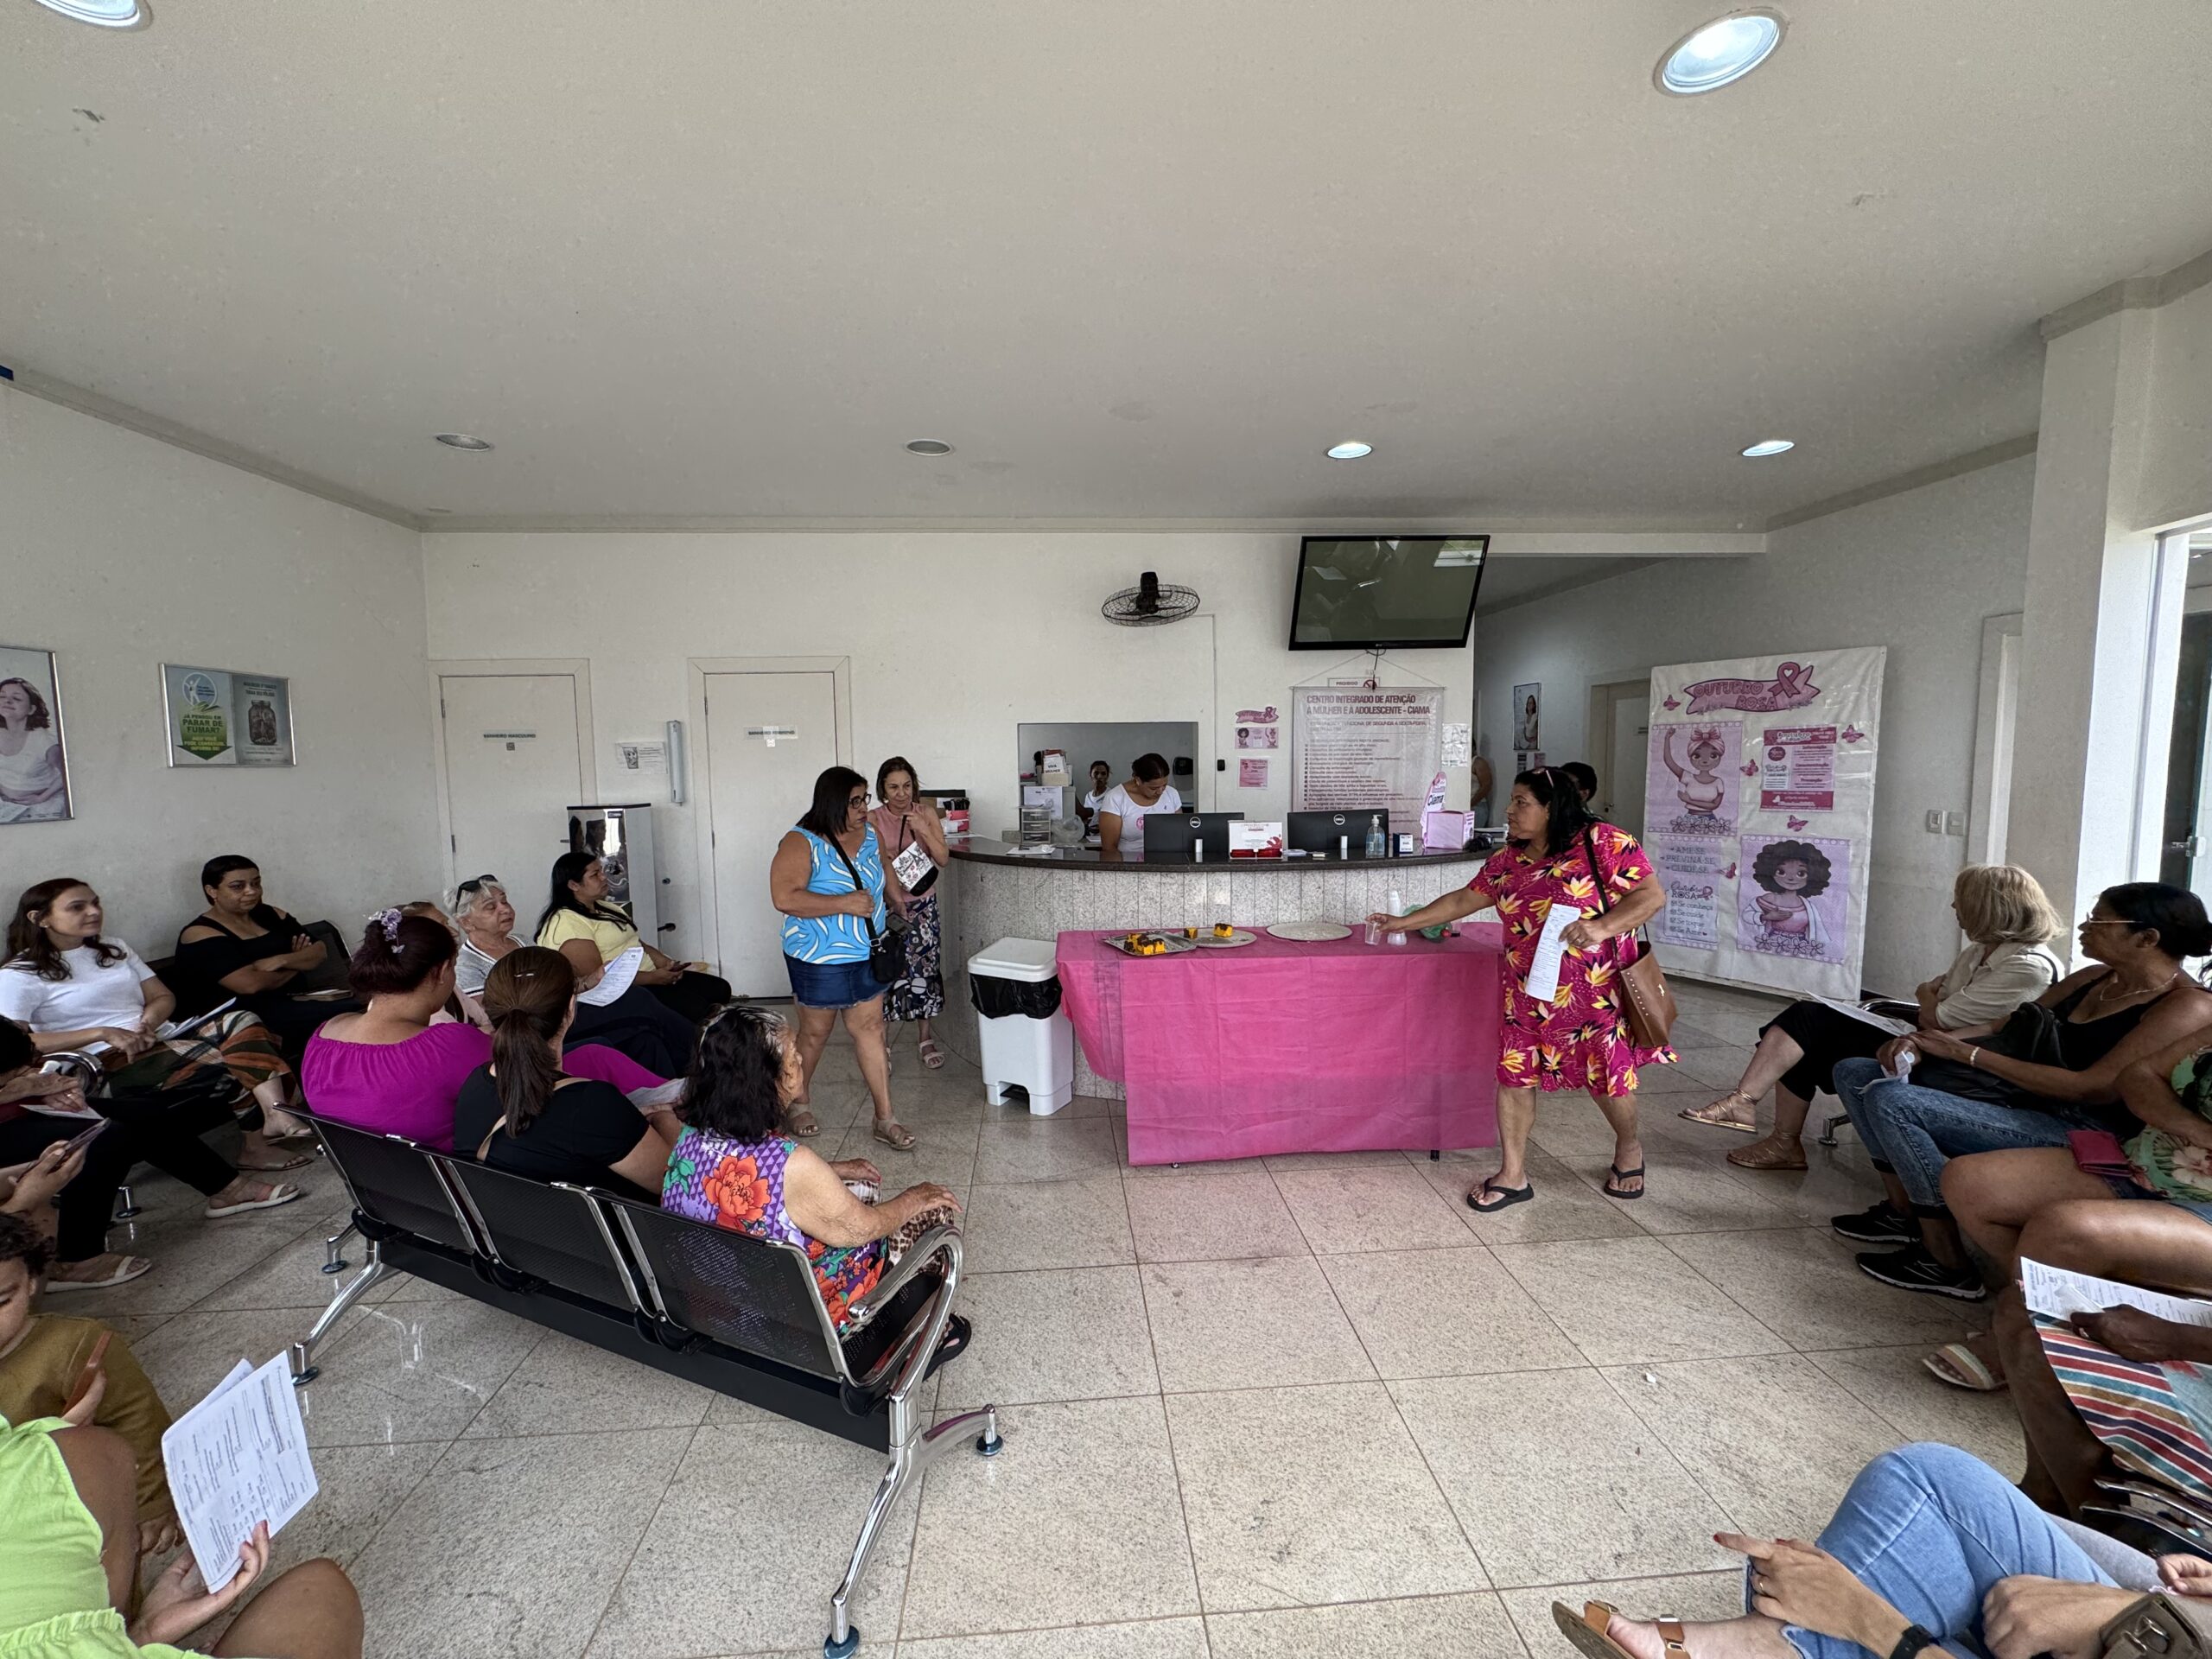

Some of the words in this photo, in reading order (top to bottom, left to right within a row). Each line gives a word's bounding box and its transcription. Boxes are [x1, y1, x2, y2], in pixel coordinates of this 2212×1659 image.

[1694, 681, 1764, 697] OUTUBRO
[1306, 695, 1335, 703] CENTRO
[1336, 695, 1374, 703] INTEGRADO
[1375, 695, 1383, 703] DE
[1385, 693, 1416, 705] ATENÇÃO
[1735, 695, 1778, 709] ROSA
[1313, 706, 1343, 715] MULHER
[1344, 706, 1348, 715] E
[1355, 706, 1402, 715] ADOLESCENTE
[1408, 706, 1430, 715] CIAMA
[1427, 794, 1445, 805] Ciama
[1672, 891, 1697, 899] ROSA
